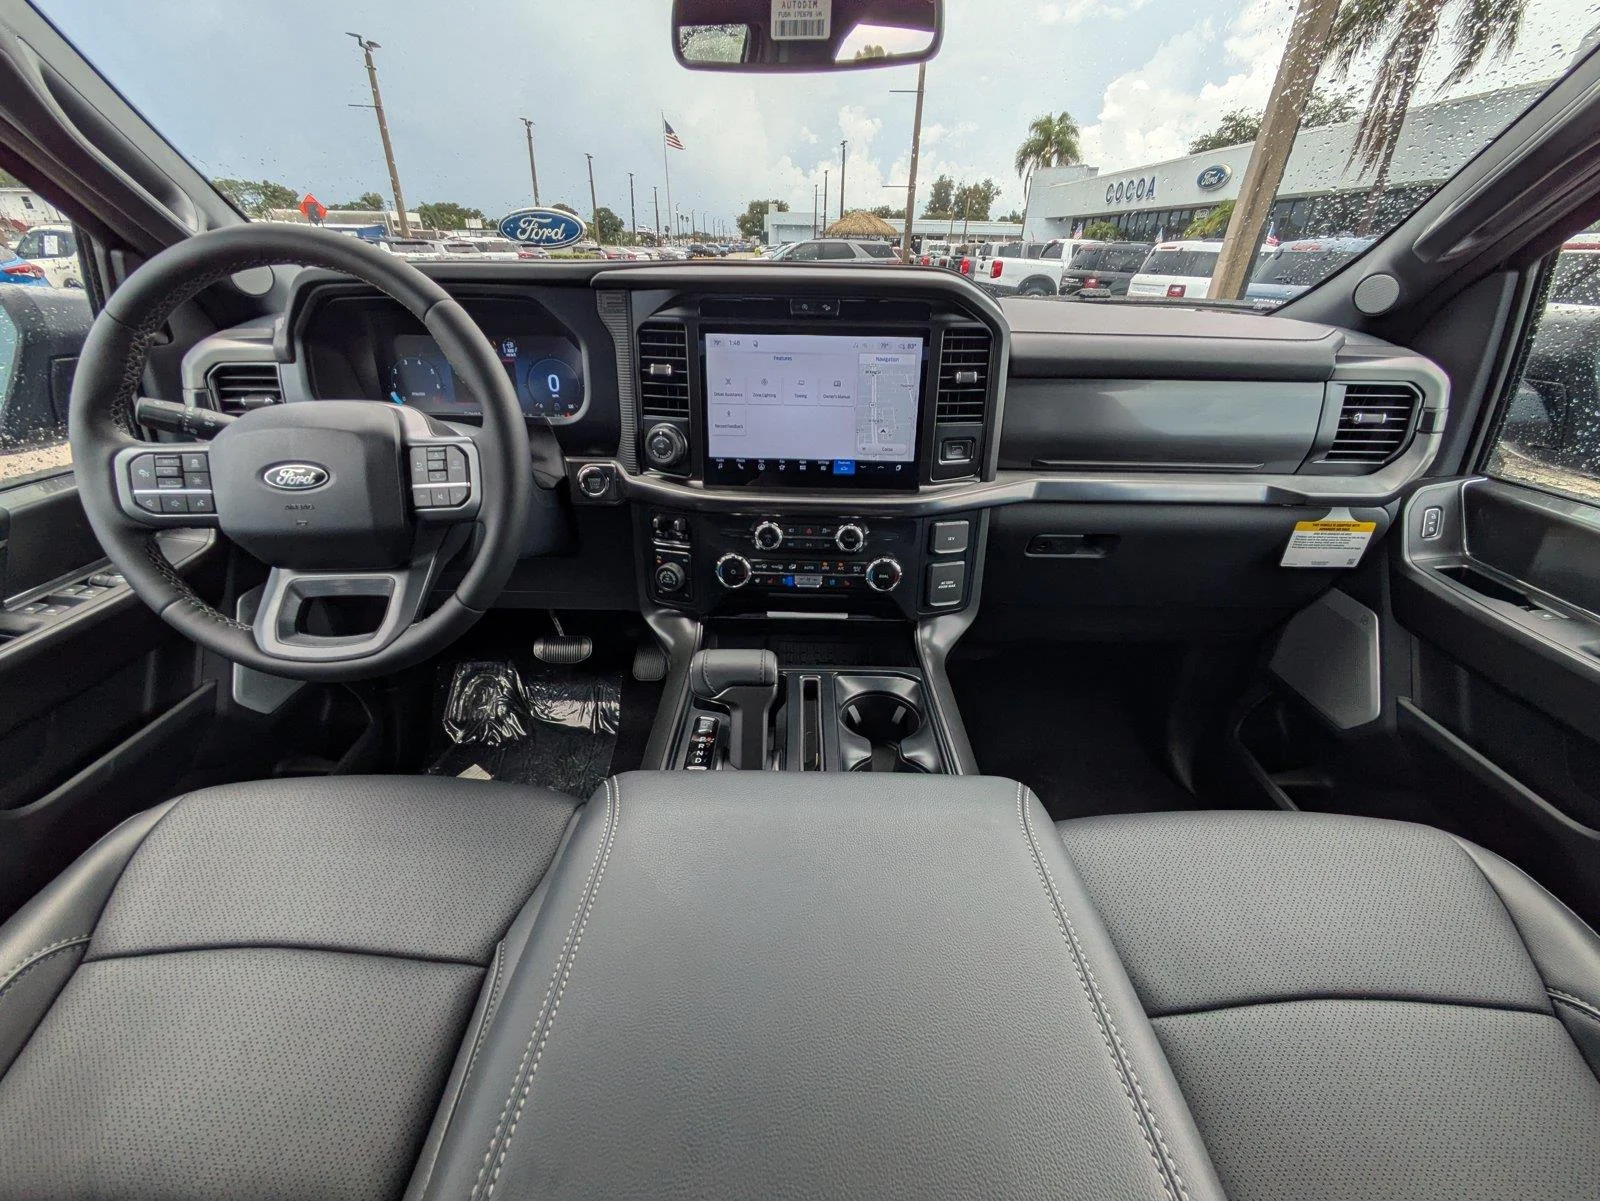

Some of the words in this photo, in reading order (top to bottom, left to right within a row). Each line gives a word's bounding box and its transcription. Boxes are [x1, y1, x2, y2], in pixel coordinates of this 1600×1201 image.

[1201, 170, 1224, 186] Ford
[1105, 176, 1156, 203] COCOA
[516, 216, 566, 240] Ford
[548, 374, 560, 392] 0
[276, 468, 316, 484] Ford
